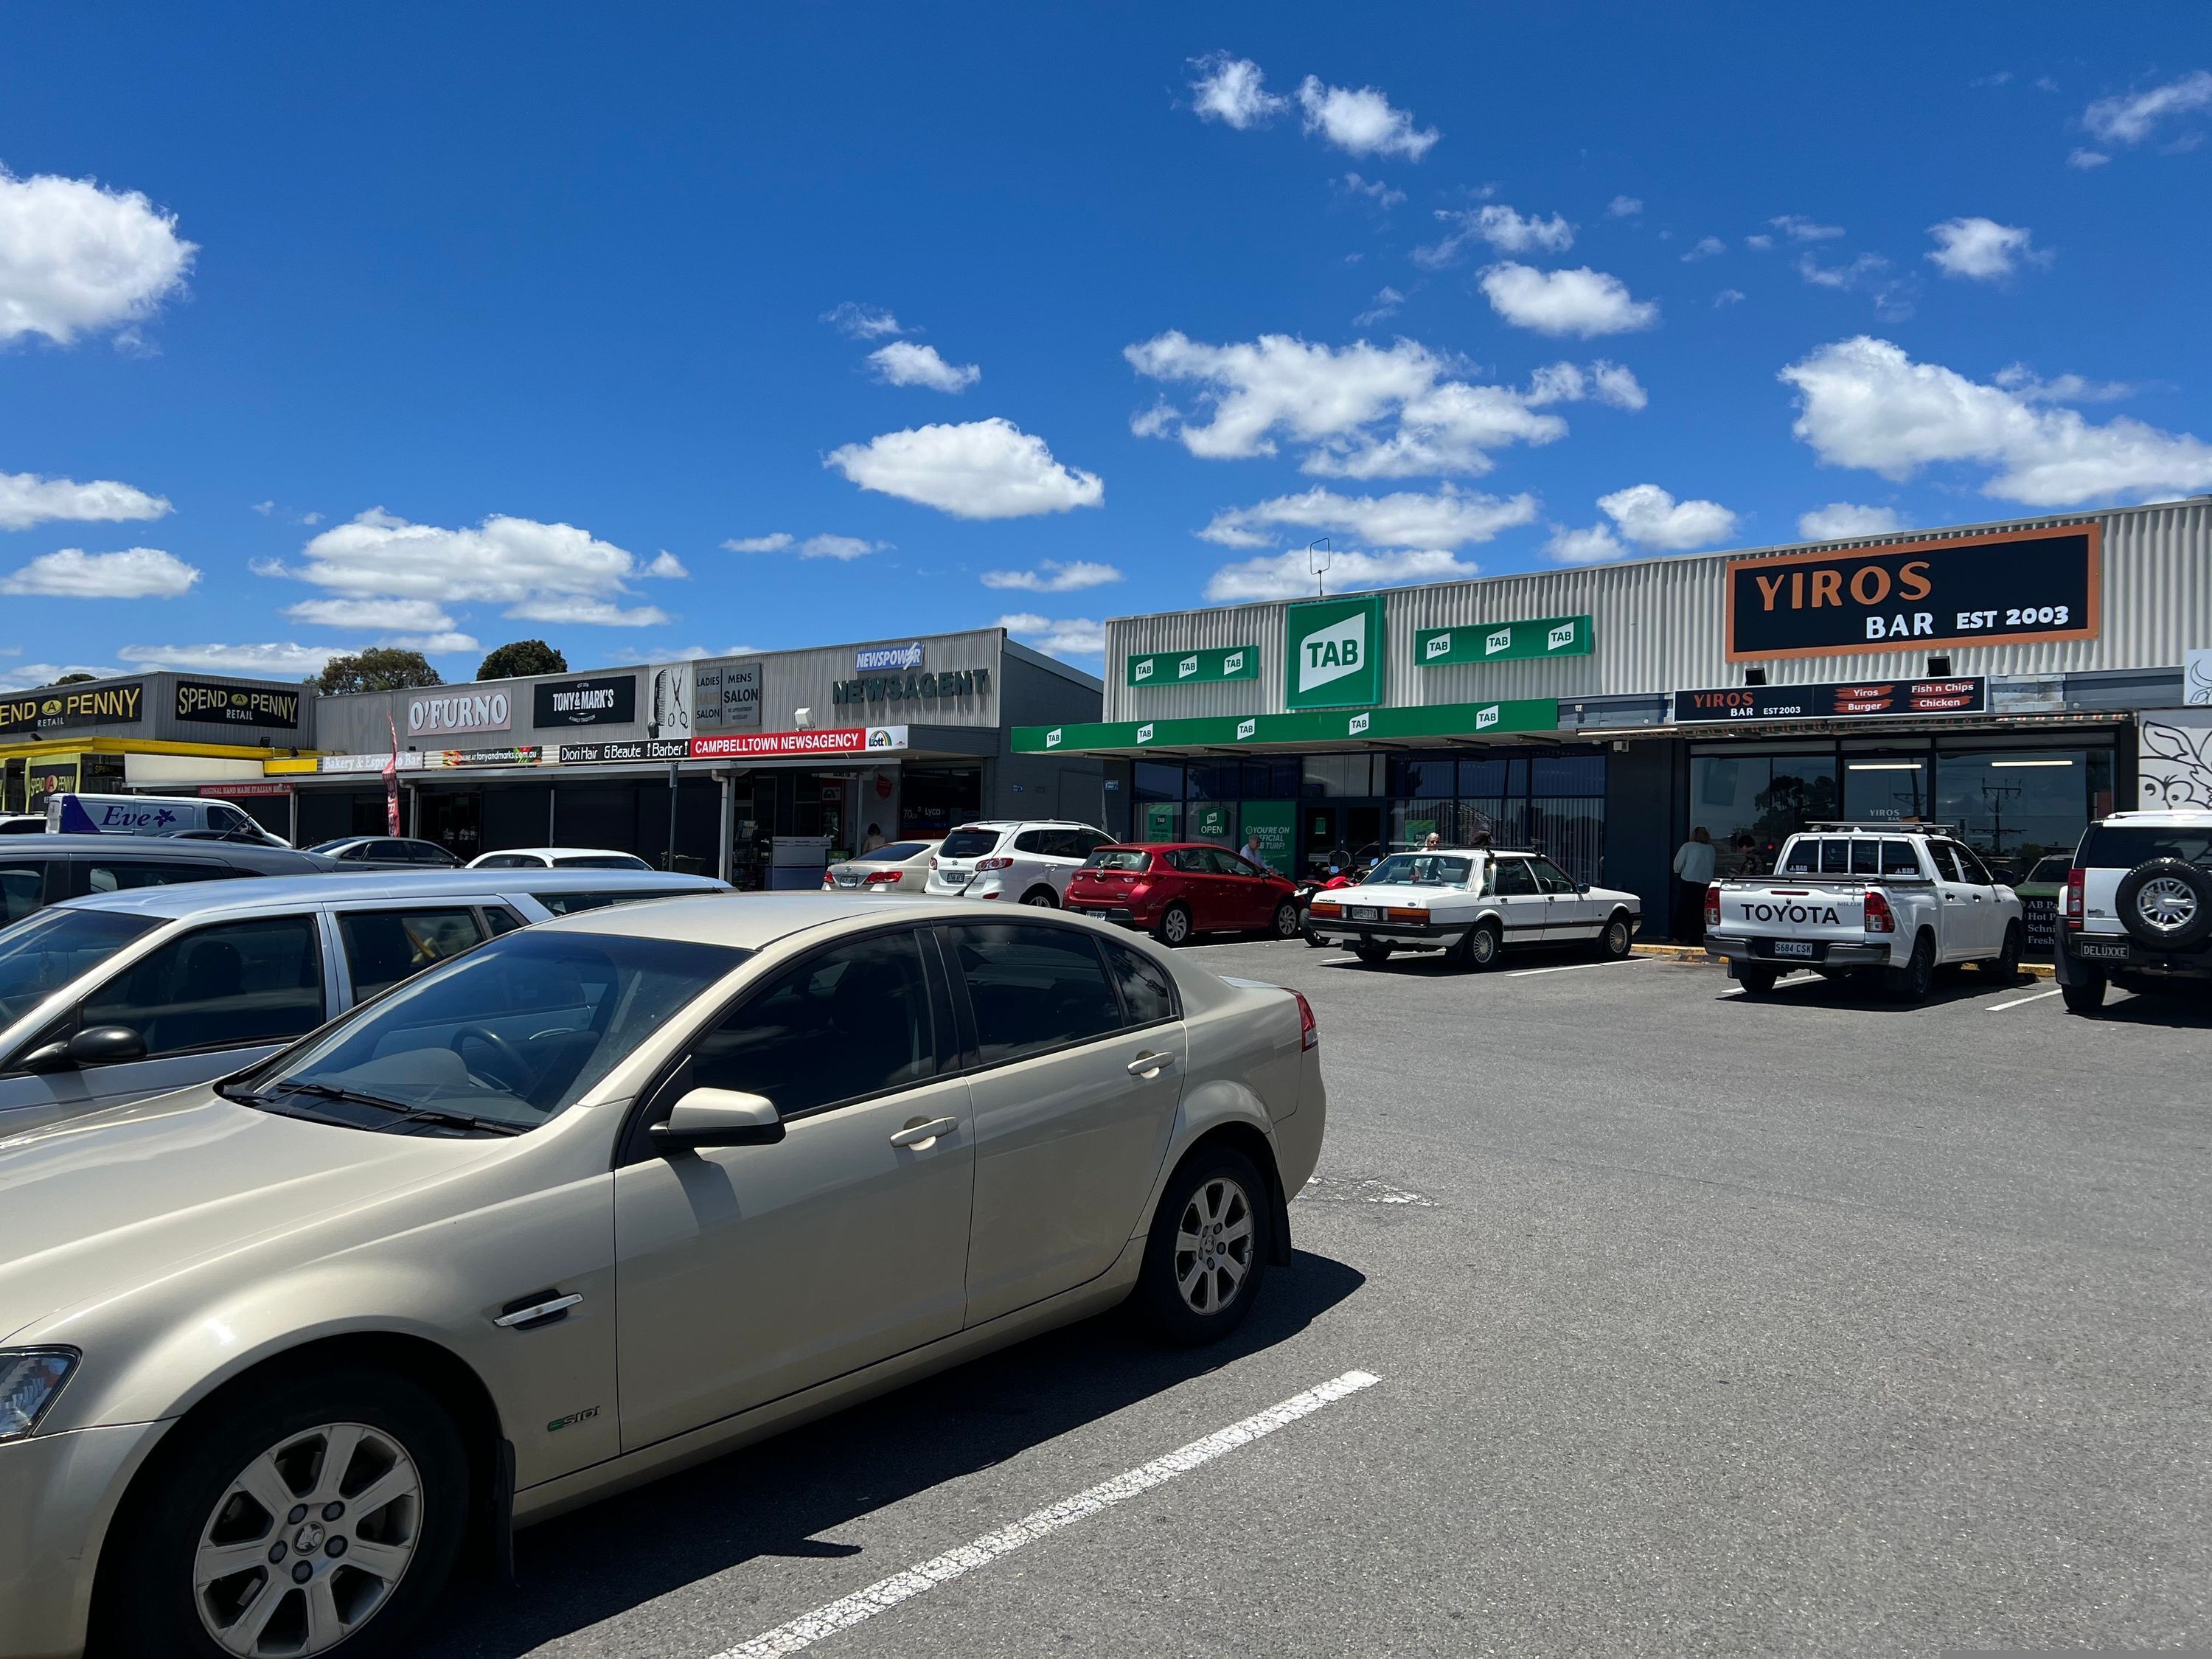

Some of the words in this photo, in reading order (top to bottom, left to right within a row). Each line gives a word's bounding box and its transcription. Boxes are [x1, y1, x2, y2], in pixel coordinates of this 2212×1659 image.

[1756, 560, 1932, 611] YIROS
[1865, 612, 1933, 639] BAR
[1956, 611, 1997, 629] EST
[2006, 606, 2069, 626] 2003
[1488, 636, 1509, 647] TAB
[1550, 630, 1573, 642] TAB
[1429, 640, 1449, 652] TAB
[1306, 639, 1359, 669] TAB
[1180, 662, 1195, 672] TAB
[1225, 658, 1242, 668] TAB
[1138, 666, 1152, 675] TAB
[696, 676, 720, 686] LADIES
[728, 673, 752, 684] MENS
[832, 669, 989, 704] NEWSAGENT
[1911, 684, 1933, 694] Fish
[1944, 683, 1975, 693] Chips
[723, 688, 758, 703] SALON
[1853, 688, 1879, 698] Yiros
[66, 688, 140, 718] PENNY
[178, 686, 228, 714] SPEND
[251, 693, 297, 723] PENNY
[1694, 692, 1754, 709] YIROS
[1919, 698, 1961, 708] Chicken
[1848, 701, 1882, 712] Burger
[226, 709, 254, 720] RETAIL
[410, 694, 509, 731] O'FURNO
[697, 709, 720, 719] SALON
[1730, 708, 1754, 717] BAR
[38, 717, 64, 727] RETAIL
[695, 737, 778, 754] CAMPBELLTOWN
[781, 733, 859, 750] NEWSAGENCY
[869, 737, 885, 747] Lott
[581, 746, 598, 759] Hair
[652, 742, 683, 757] Barber
[324, 756, 355, 770] Bakery
[355, 755, 363, 768] &
[365, 755, 402, 769] Espreo
[405, 754, 421, 766] Bar
[100, 805, 151, 827] Eve
[1200, 825, 1222, 834] OPEN
[1253, 826, 1278, 834] YOU'RE
[1278, 826, 1290, 834] ON
[1258, 834, 1284, 842] FFICIAL
[2028, 900, 2043, 909] AB
[1740, 904, 1840, 925] TOYOTA
[2028, 912, 2046, 921] Hot
[2028, 936, 2054, 945] Fresh
[1775, 943, 1793, 953] S684
[1796, 944, 1812, 953] CSK
[2083, 945, 2126, 958] DELUXXE
